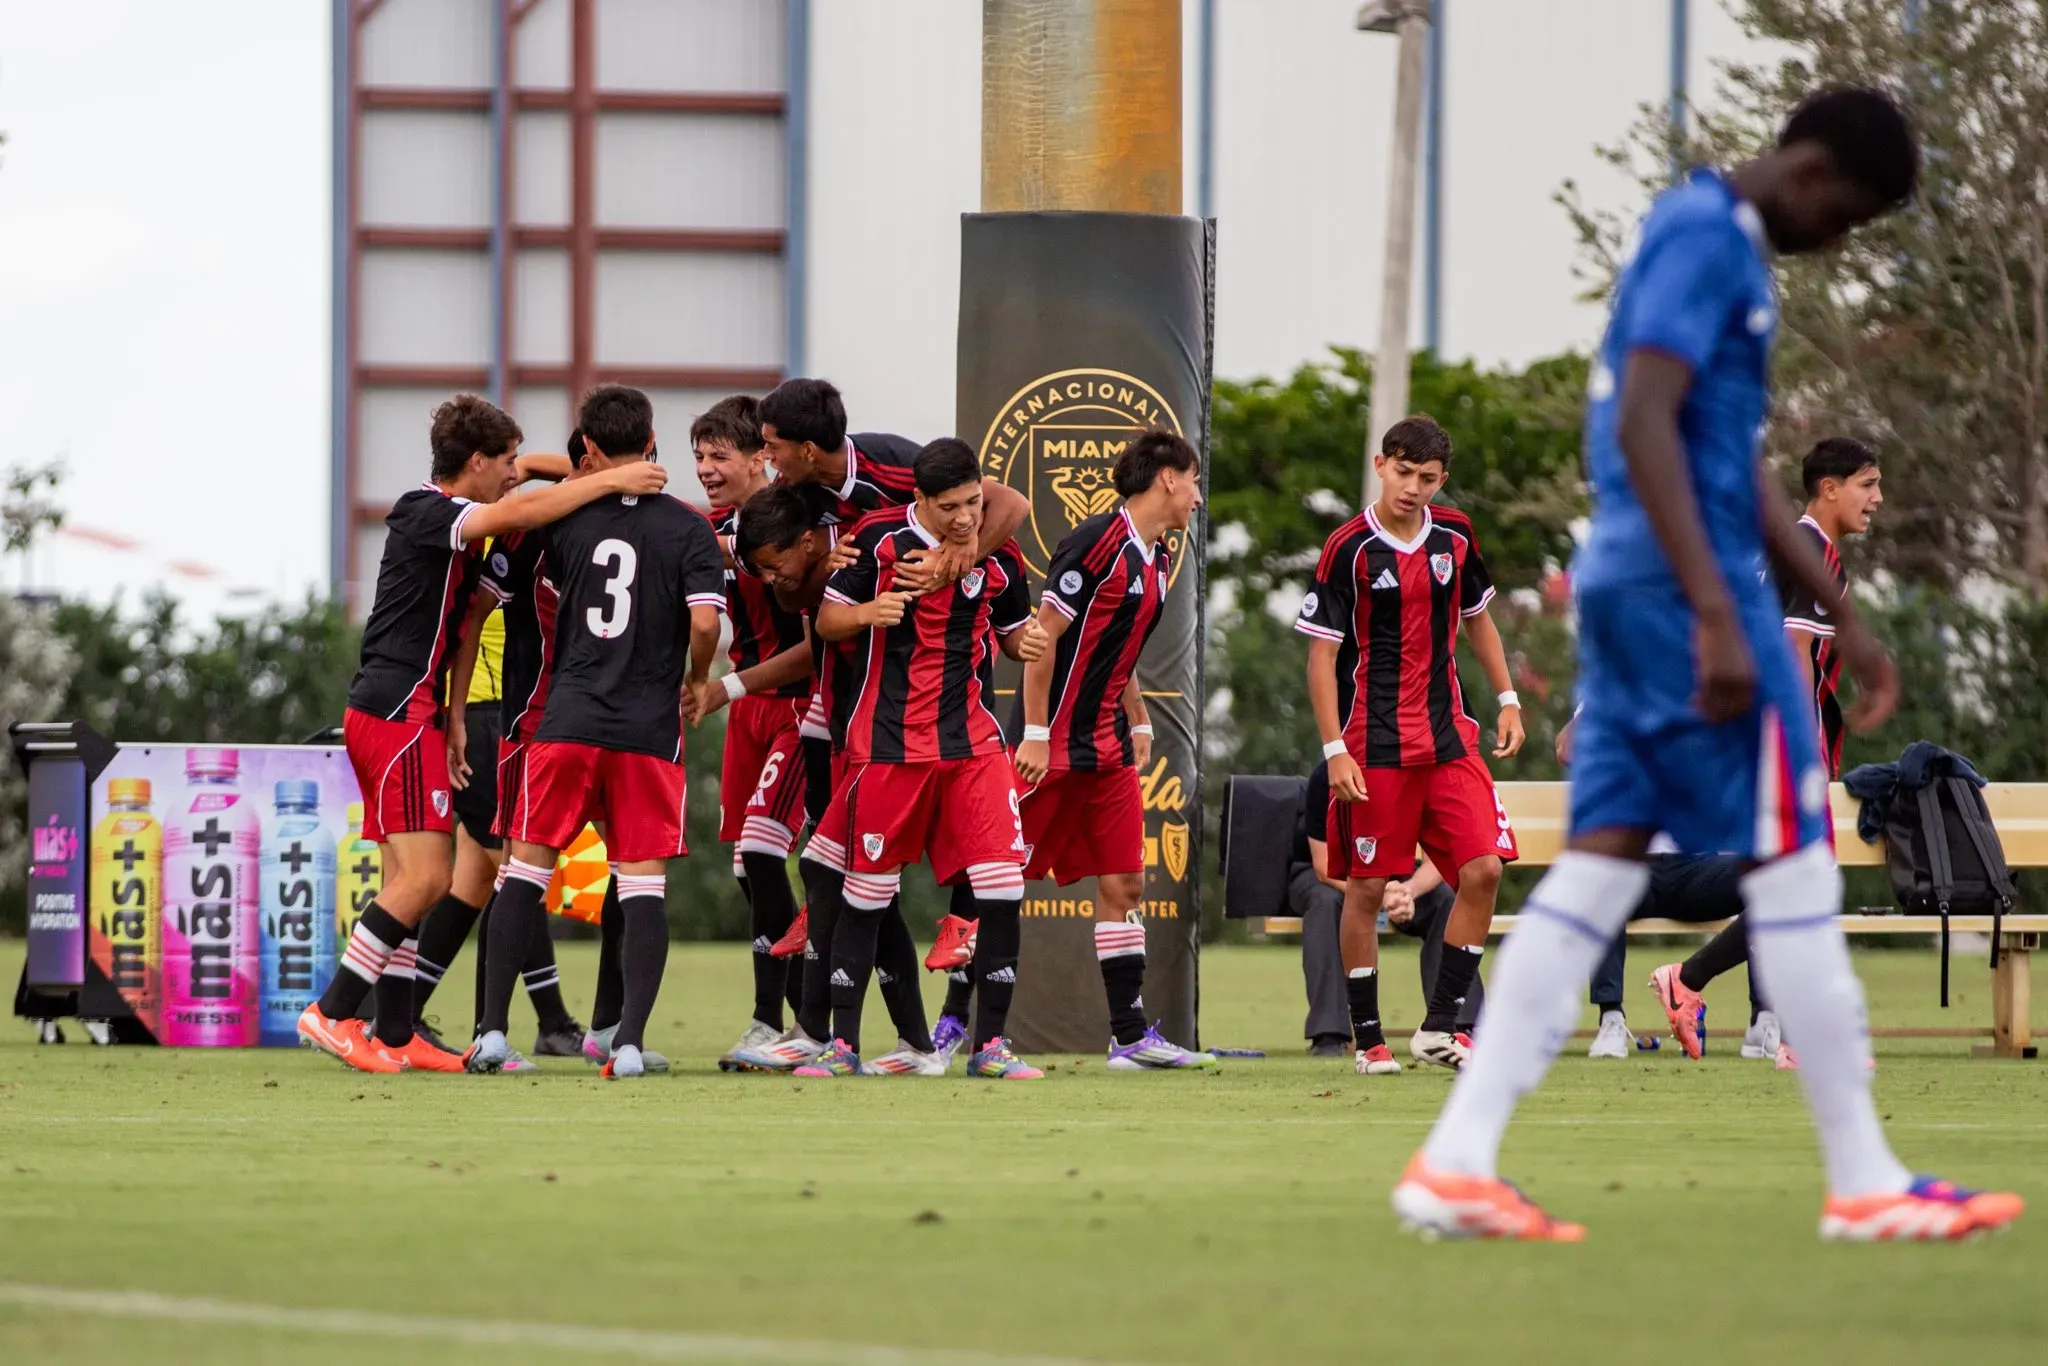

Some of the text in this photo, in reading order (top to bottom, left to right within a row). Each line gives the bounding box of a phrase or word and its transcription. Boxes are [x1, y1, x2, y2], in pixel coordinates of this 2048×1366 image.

[1043, 439, 1128, 458] MIAM
[586, 538, 638, 639] 3
[759, 751, 785, 789] 6
[101, 839, 145, 987] más+
[178, 817, 232, 998] más+
[268, 840, 313, 990] más+
[177, 1012, 242, 1024] MESSI
[267, 1000, 306, 1011] MES
